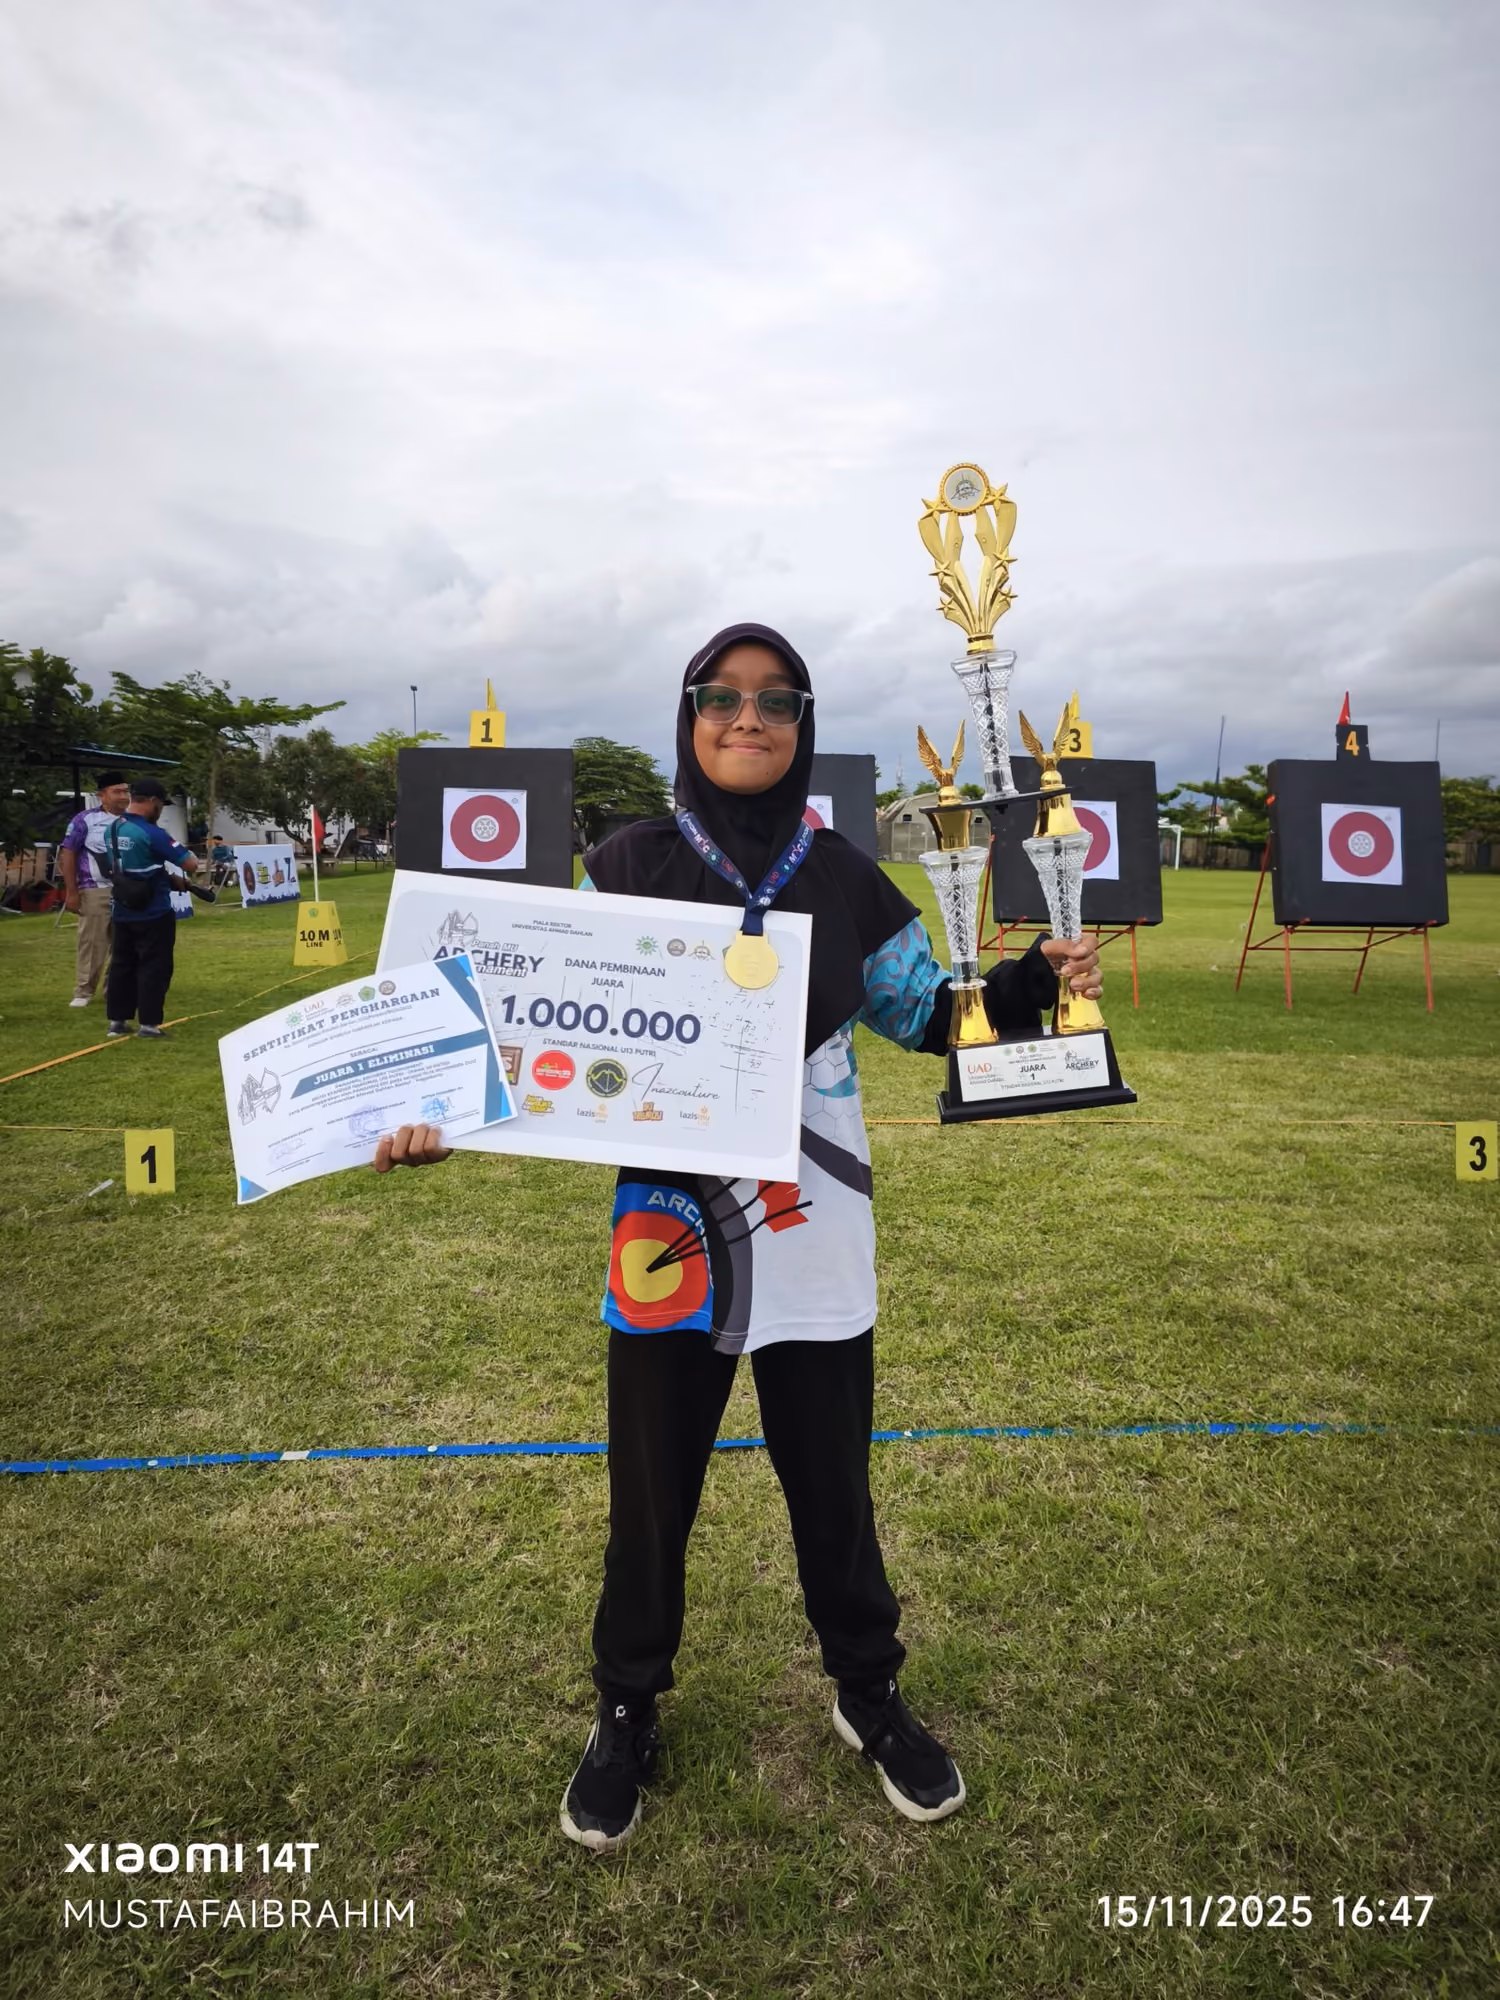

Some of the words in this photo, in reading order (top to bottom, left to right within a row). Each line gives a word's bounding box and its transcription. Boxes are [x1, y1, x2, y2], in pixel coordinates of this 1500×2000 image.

[480, 718, 493, 743] 1
[1069, 728, 1081, 752] 3
[1345, 730, 1360, 756] 4
[299, 930, 316, 941] 10
[318, 930, 329, 941] M
[512, 923, 548, 932] UNIVERSITAS
[564, 957, 598, 970] DANA
[600, 961, 666, 977] PEMBINAAN
[591, 977, 625, 989] JUARA
[604, 989, 610, 999] 1
[243, 1019, 325, 1062] SERTIFIKAT
[331, 988, 440, 1024] PENGHARGAAN
[502, 994, 701, 1044] 1.000.000
[543, 1038, 579, 1048] STANDAR
[579, 1042, 619, 1053] NASIONAL
[635, 1048, 657, 1057] PUTRI
[314, 1065, 355, 1085] JUARA
[367, 1044, 435, 1068] ELIMINASI
[967, 1062, 993, 1074] UAD
[1020, 1063, 1047, 1073] JUARA
[1065, 1060, 1099, 1070] ARCHERY
[1469, 1135, 1487, 1172] 3
[140, 1145, 157, 1184] 1
